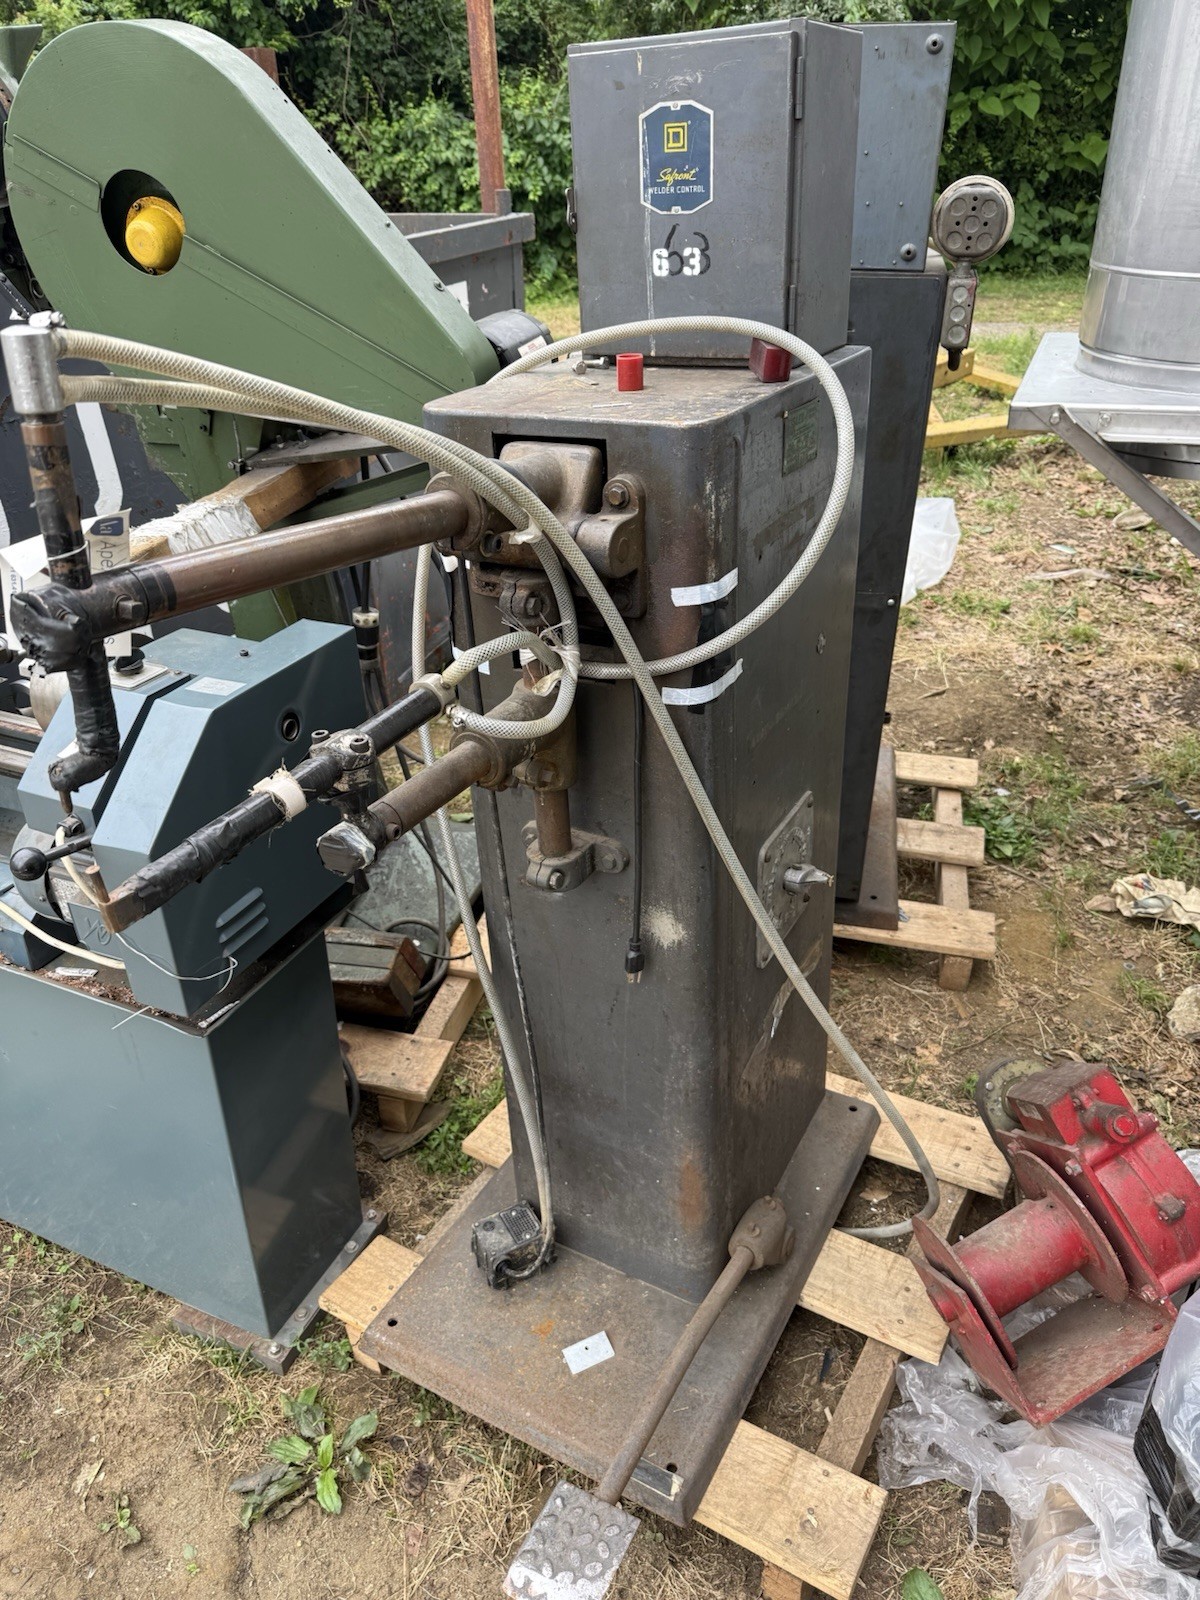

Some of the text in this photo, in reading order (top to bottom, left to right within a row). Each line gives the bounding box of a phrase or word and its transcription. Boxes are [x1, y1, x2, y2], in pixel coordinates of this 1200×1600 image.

[649, 185, 706, 195] WELDER CONTROL
[652, 246, 701, 277] 63
